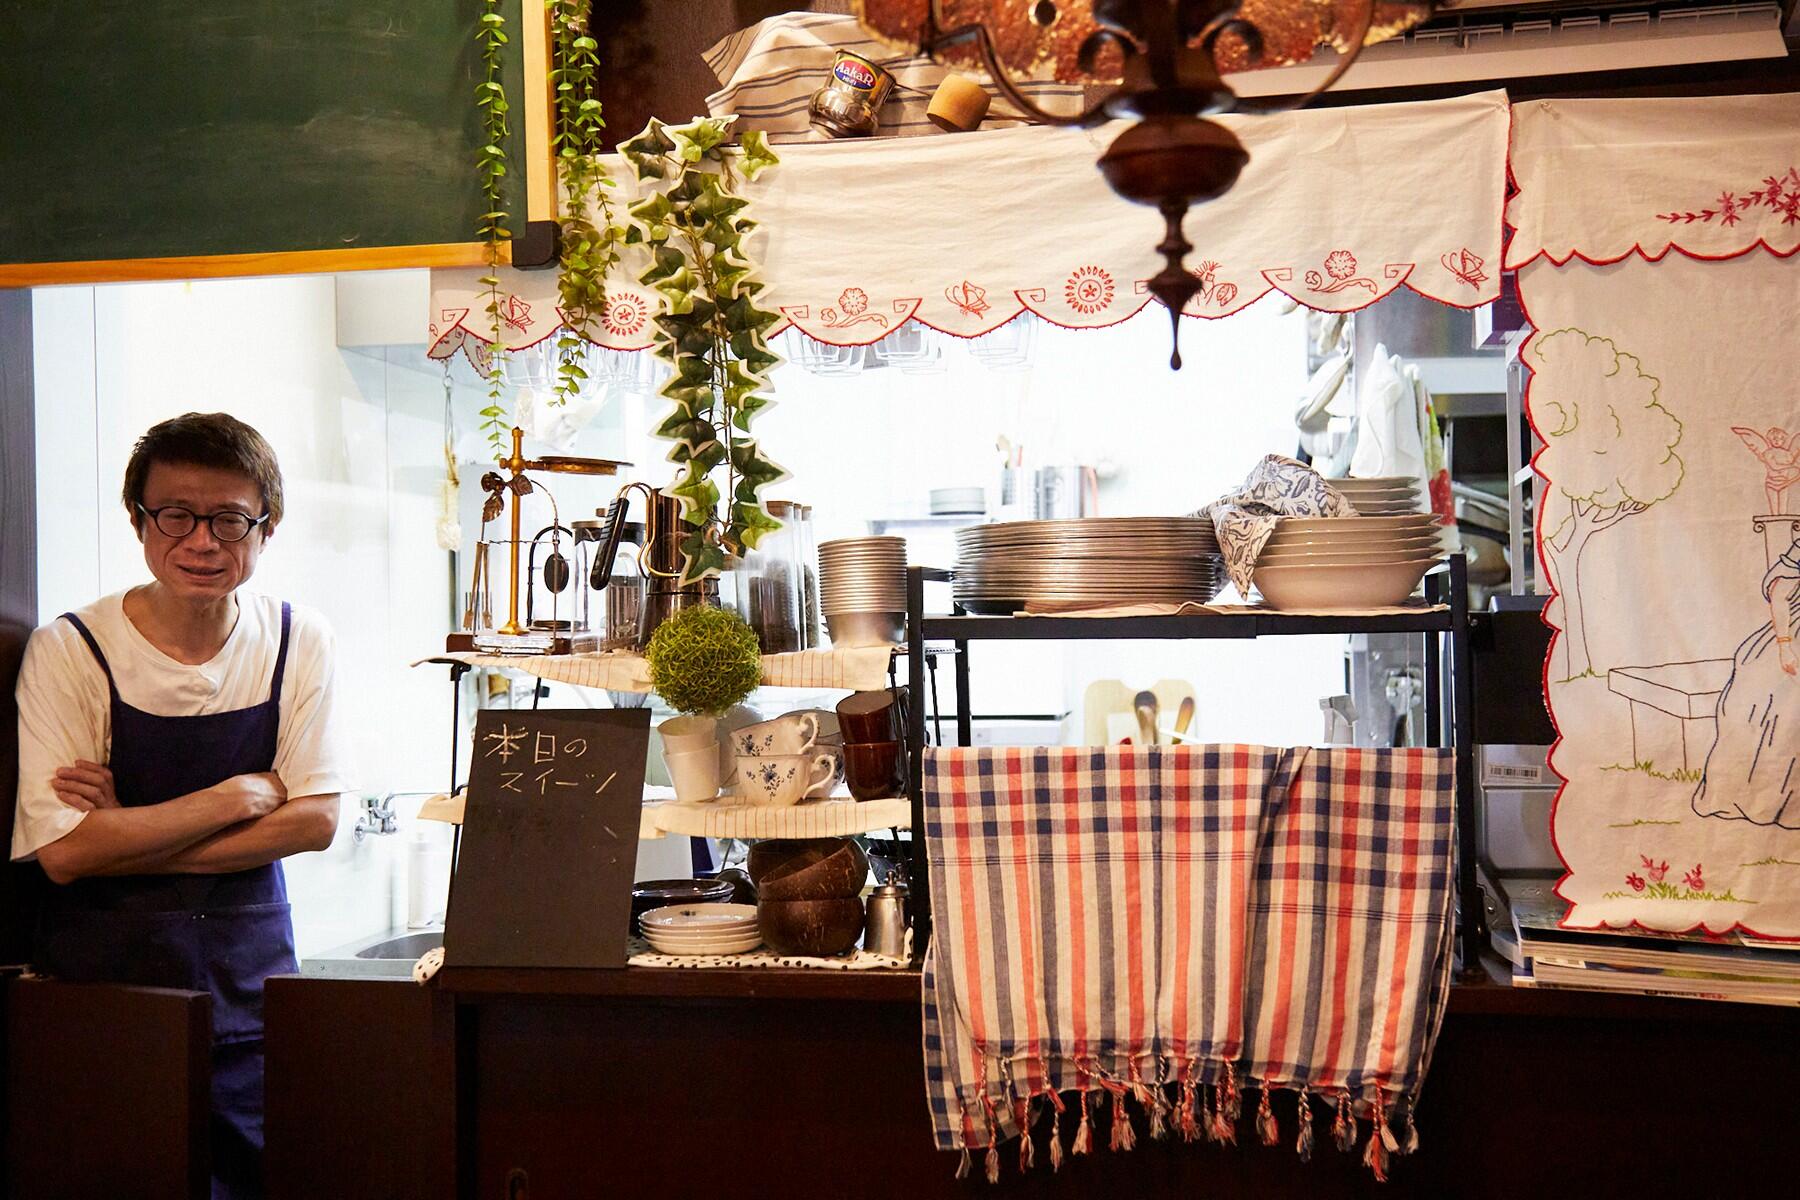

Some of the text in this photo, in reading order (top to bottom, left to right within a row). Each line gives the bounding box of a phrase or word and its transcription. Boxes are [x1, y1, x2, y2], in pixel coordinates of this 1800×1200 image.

[483, 722, 588, 765] 本日の
[500, 768, 617, 795] スイーツ
